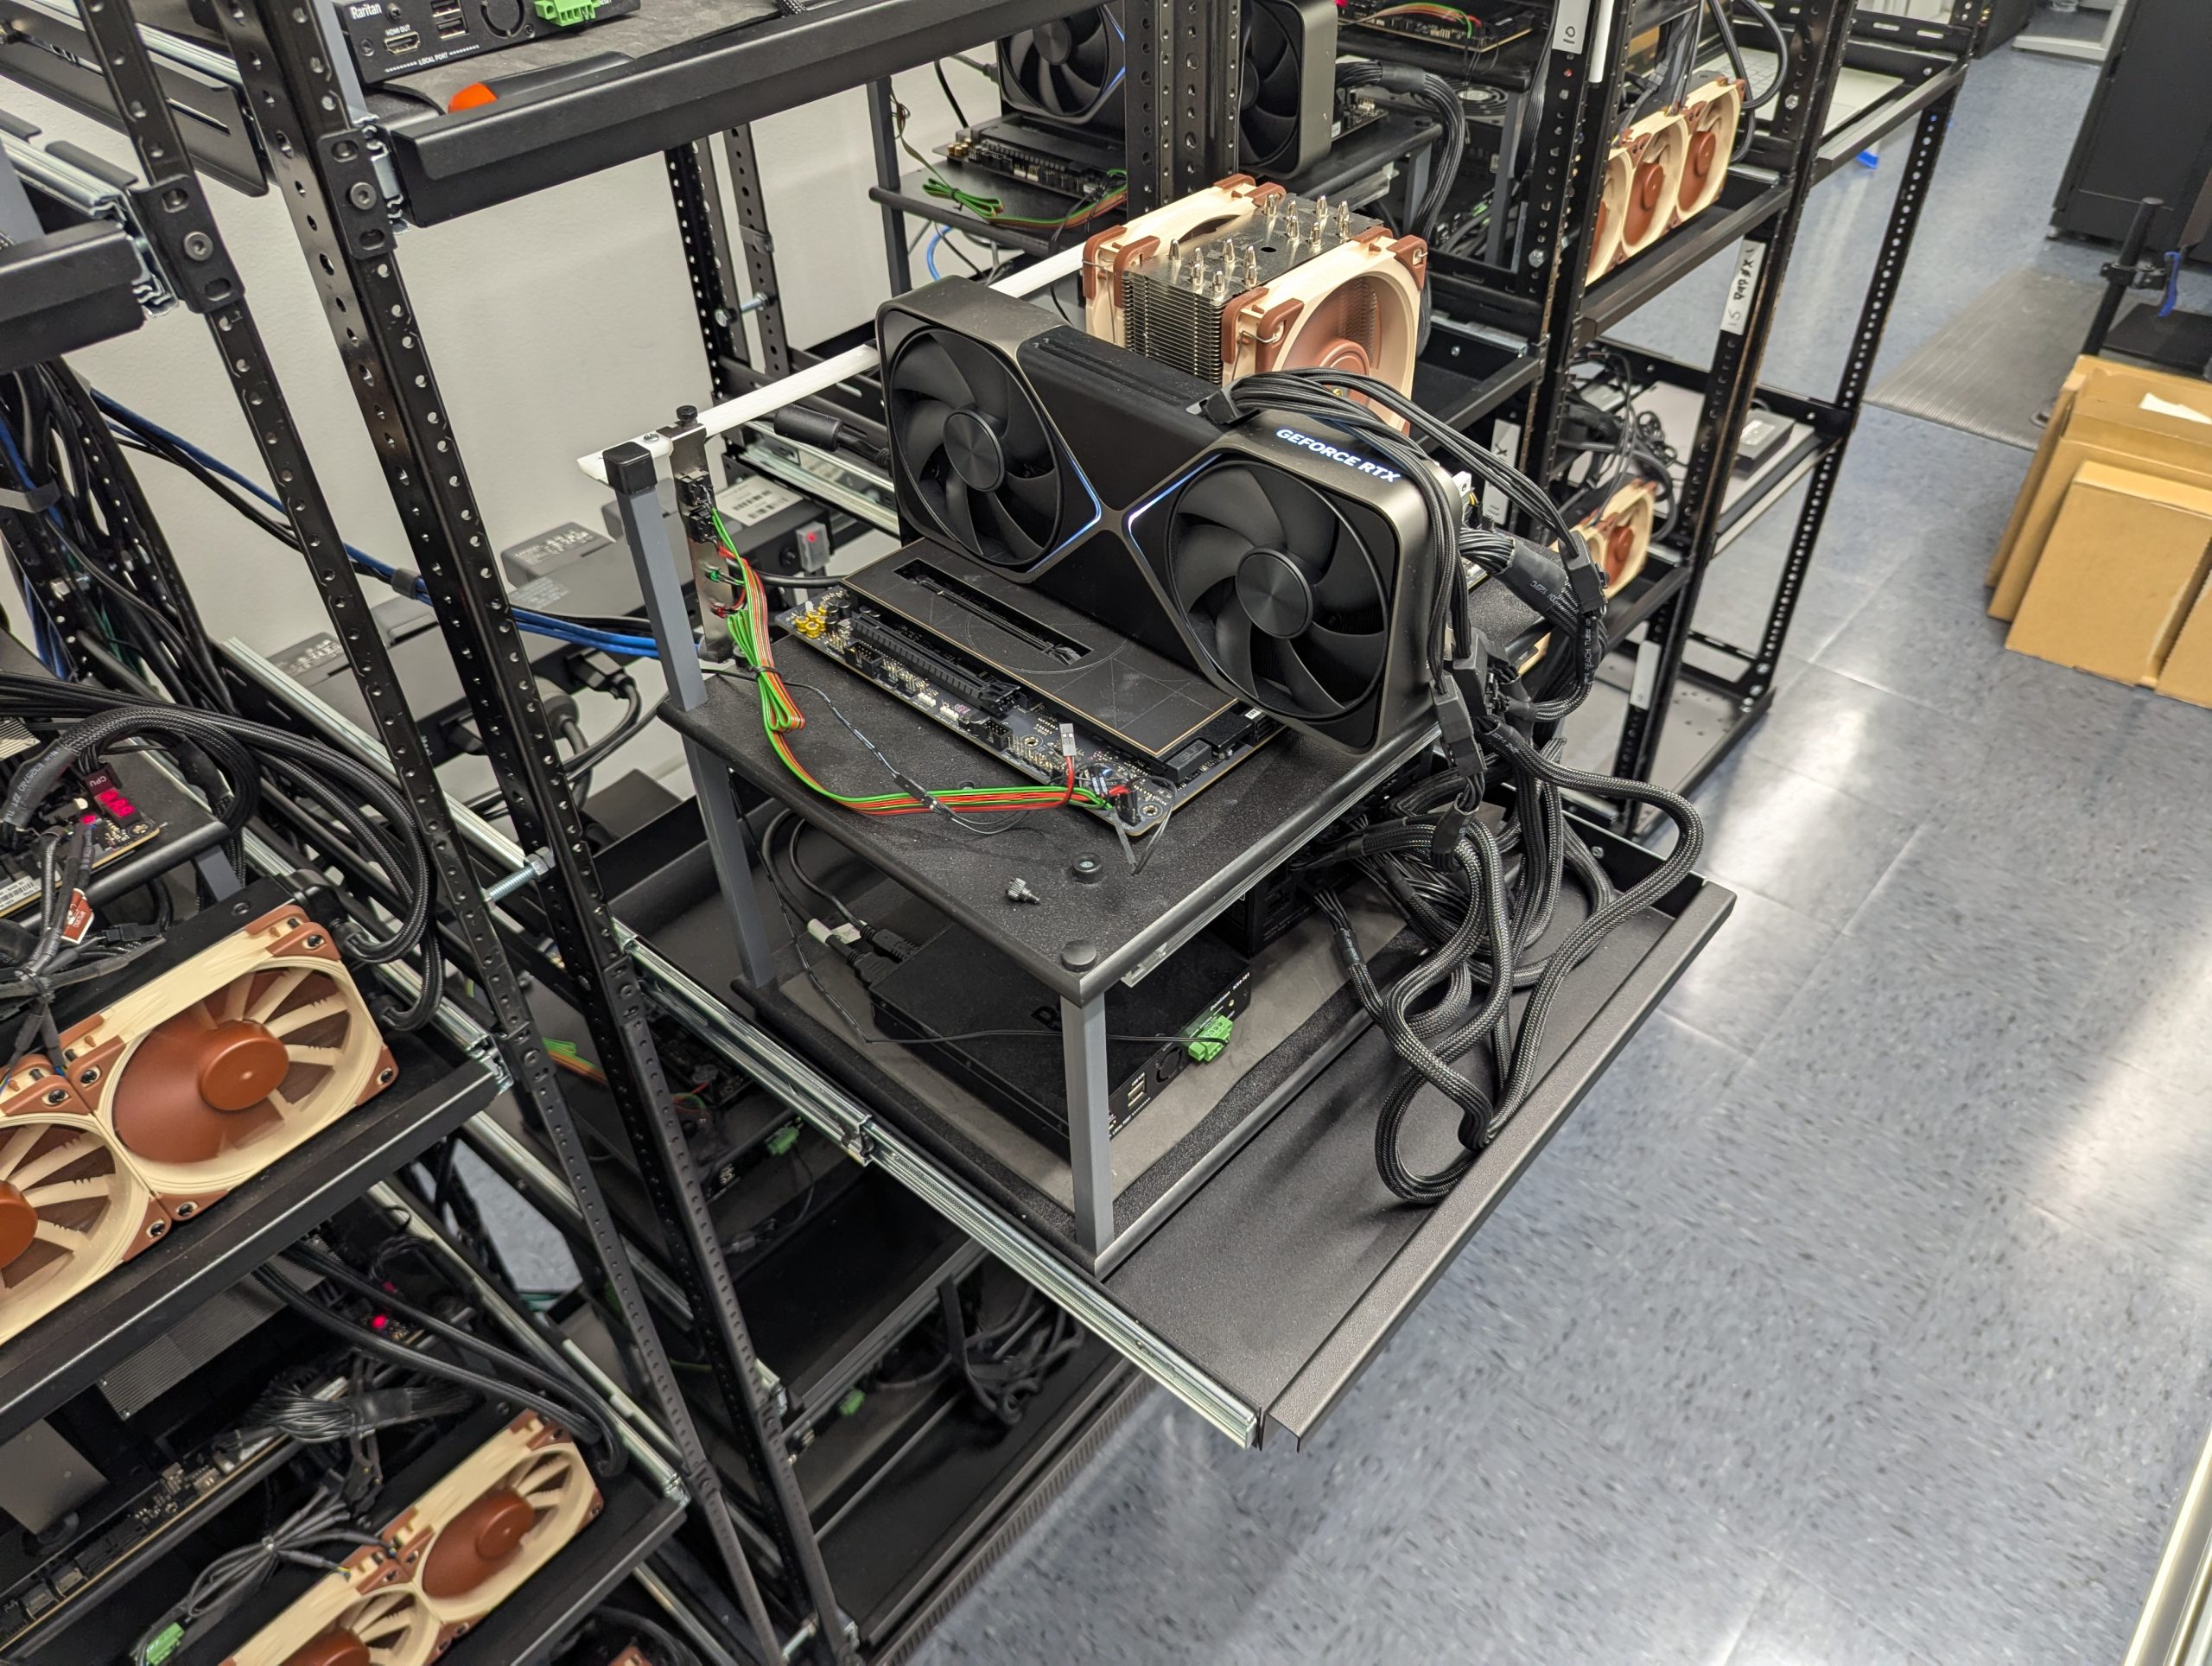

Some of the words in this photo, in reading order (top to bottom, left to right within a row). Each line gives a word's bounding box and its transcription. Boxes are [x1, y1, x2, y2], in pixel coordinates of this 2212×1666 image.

[350, 3, 382, 20] Raritan
[385, 27, 402, 36] HDMI
[401, 23, 411, 32] OUT
[417, 55, 435, 66] LOCAL
[434, 51, 448, 61] PORT
[1275, 429, 1362, 467] GEFORCE
[1357, 461, 1401, 483] RTX
[89, 775, 107, 787] CPU
